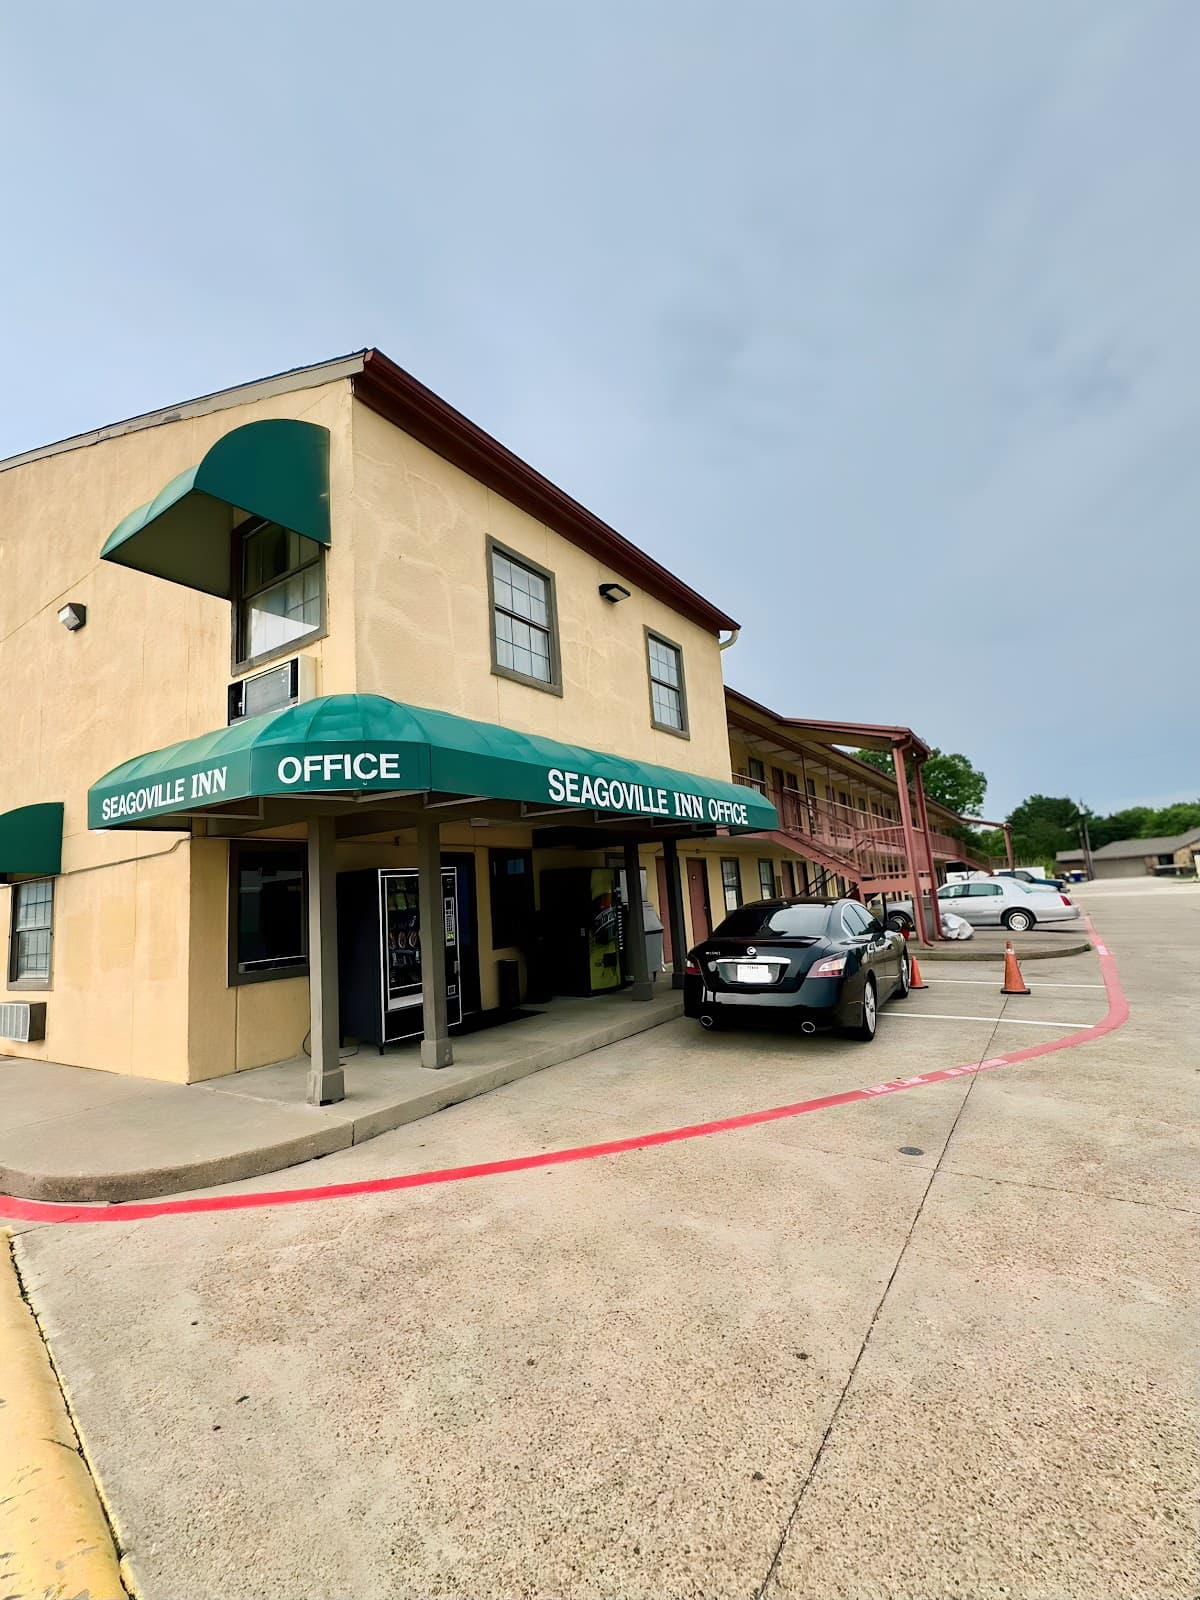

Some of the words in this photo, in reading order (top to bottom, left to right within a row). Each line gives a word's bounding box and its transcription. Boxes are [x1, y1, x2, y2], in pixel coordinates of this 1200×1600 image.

[101, 778, 186, 821] SEAGOVILLE
[190, 766, 228, 799] INN
[277, 752, 401, 784] OFFICE
[548, 768, 669, 815] SEAGOVILLE
[673, 791, 705, 819] INN
[708, 798, 749, 825] OFFICE
